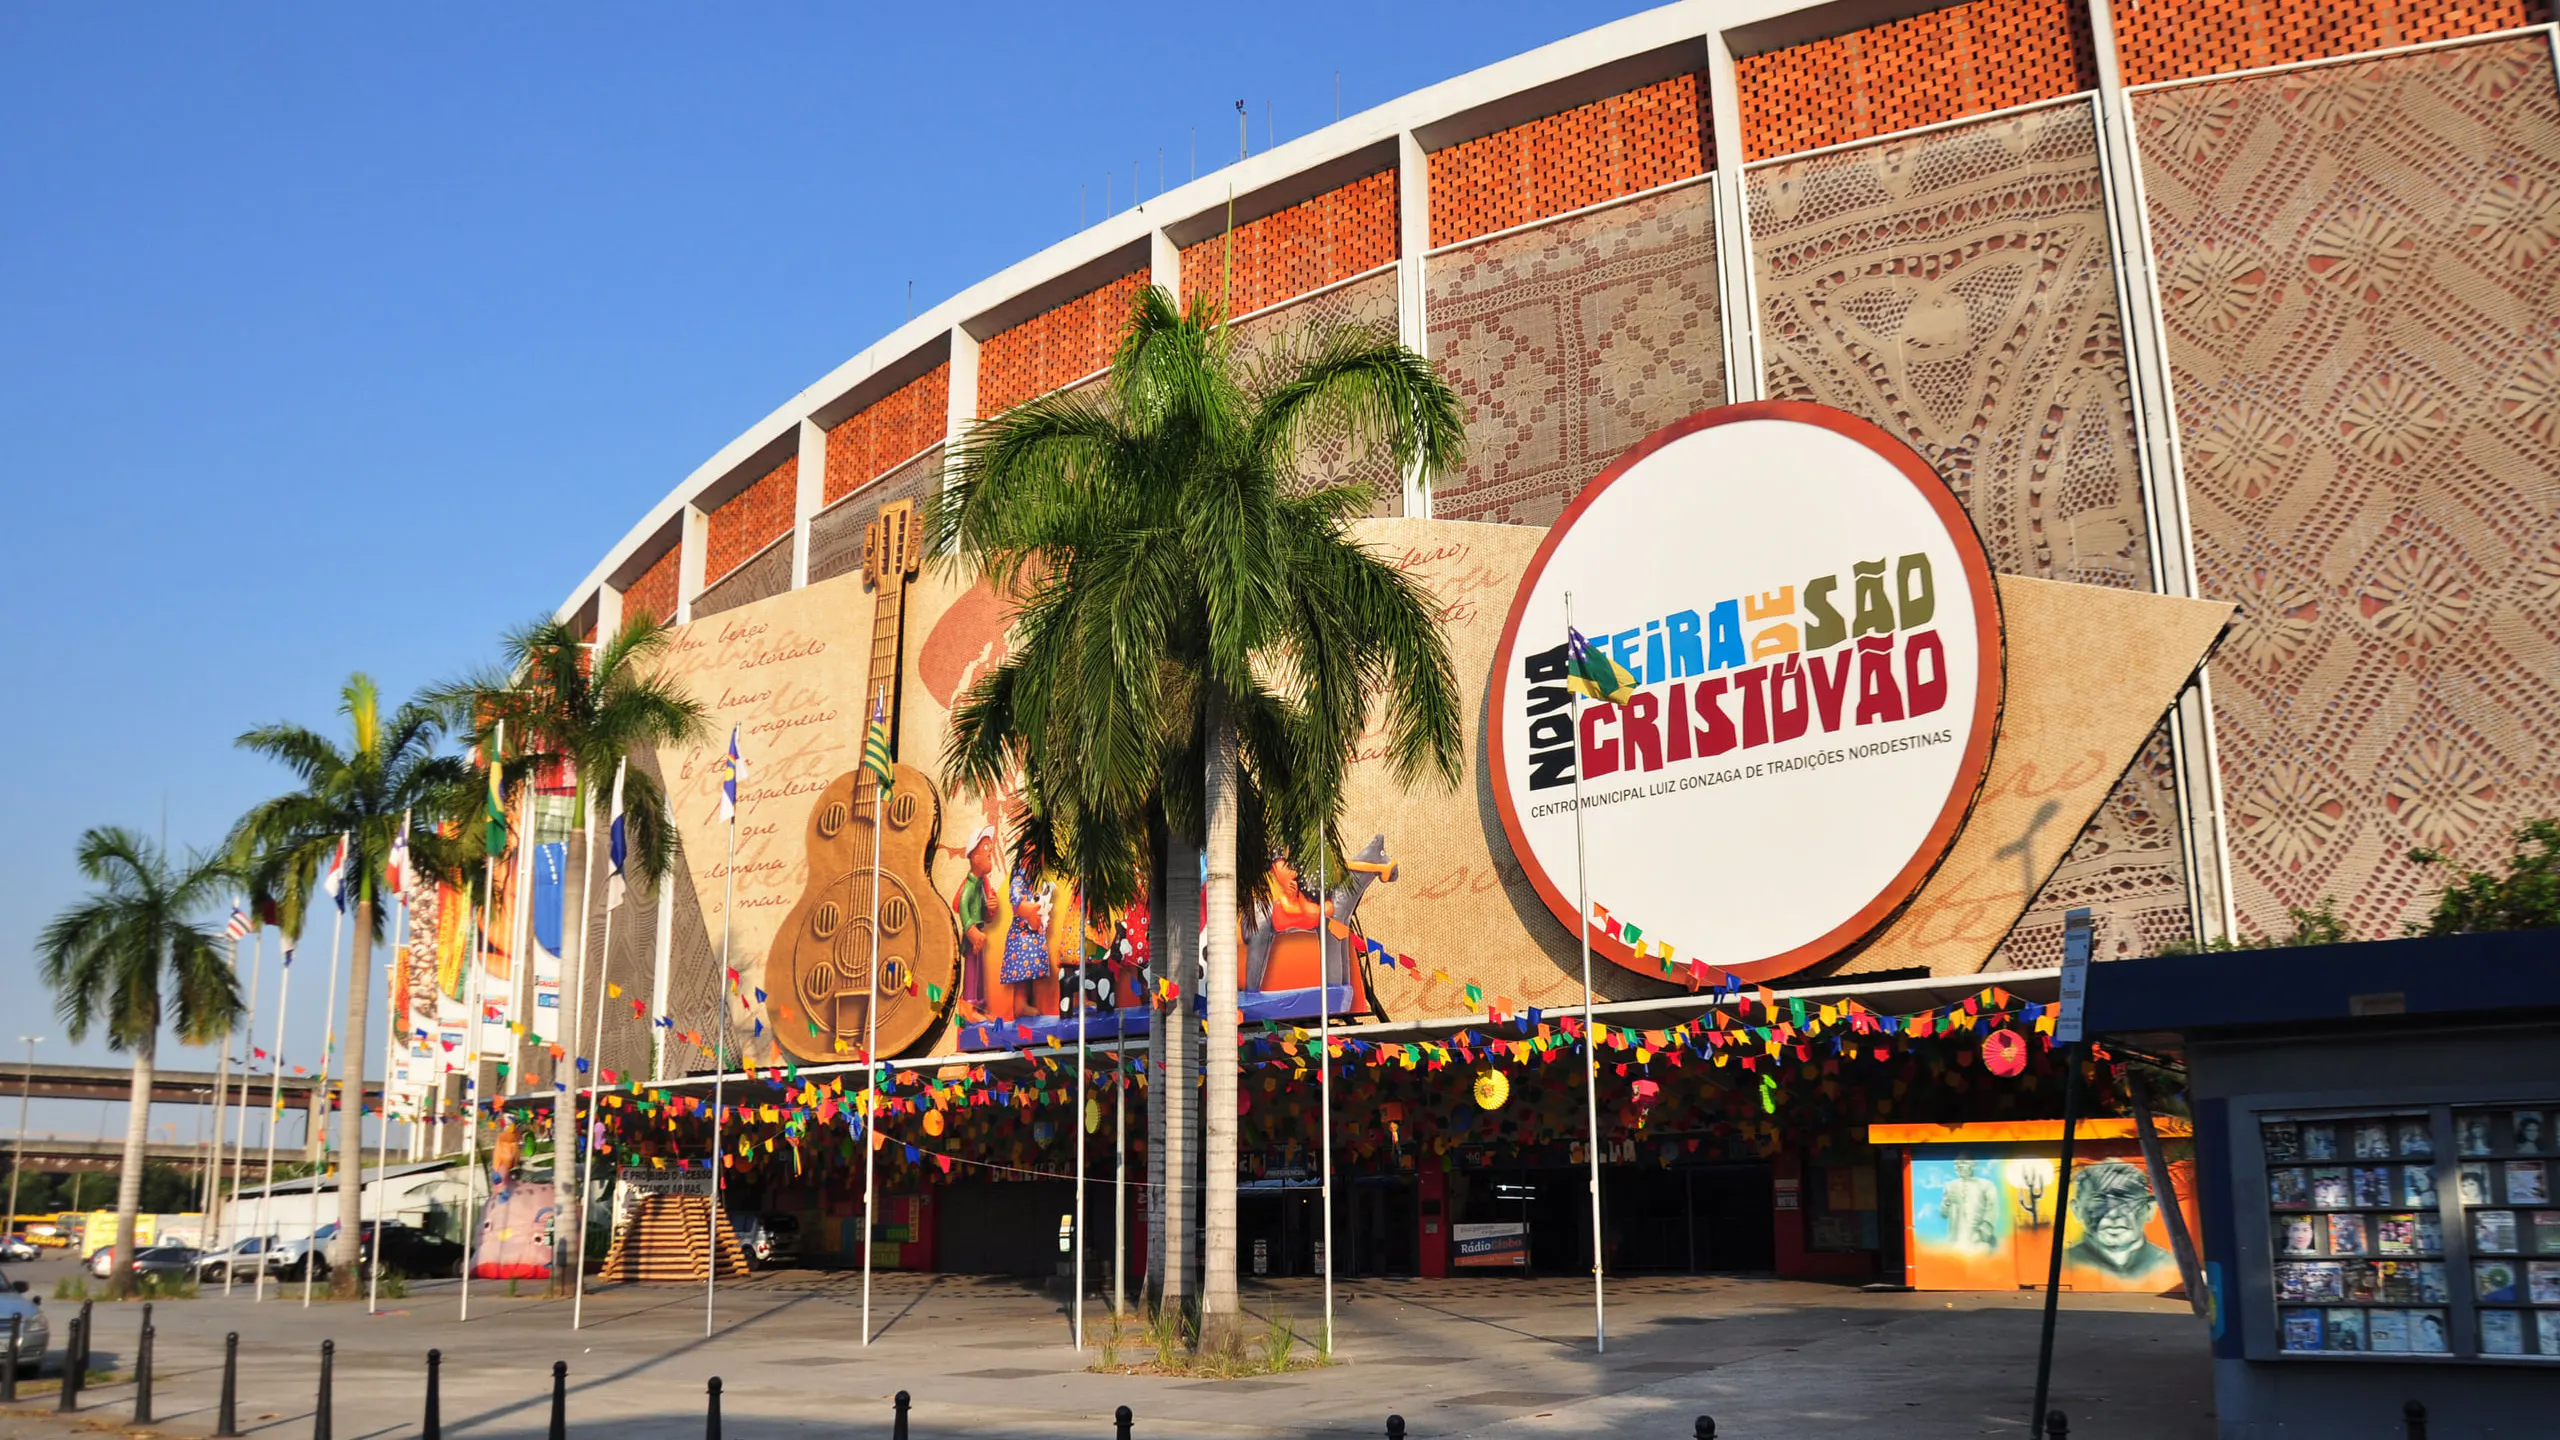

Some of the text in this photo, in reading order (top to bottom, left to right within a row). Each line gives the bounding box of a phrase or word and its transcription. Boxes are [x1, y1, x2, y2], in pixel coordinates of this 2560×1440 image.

[738, 640, 826, 670] adorado
[1525, 642, 1577, 791] NOVA
[1744, 585, 1799, 662] DE
[1803, 552, 1936, 651] SÃO
[717, 688, 772, 710] bravo
[1579, 629, 1947, 781] CRISTÓVÃO
[748, 710, 838, 748] vaqueiro
[1531, 729, 1952, 818] CENTRO MUNICIPAL LUIZ GONZAGA DE TRADIÇÕES NORDESTINAS
[735, 823, 779, 855] que
[704, 858, 787, 880] domina
